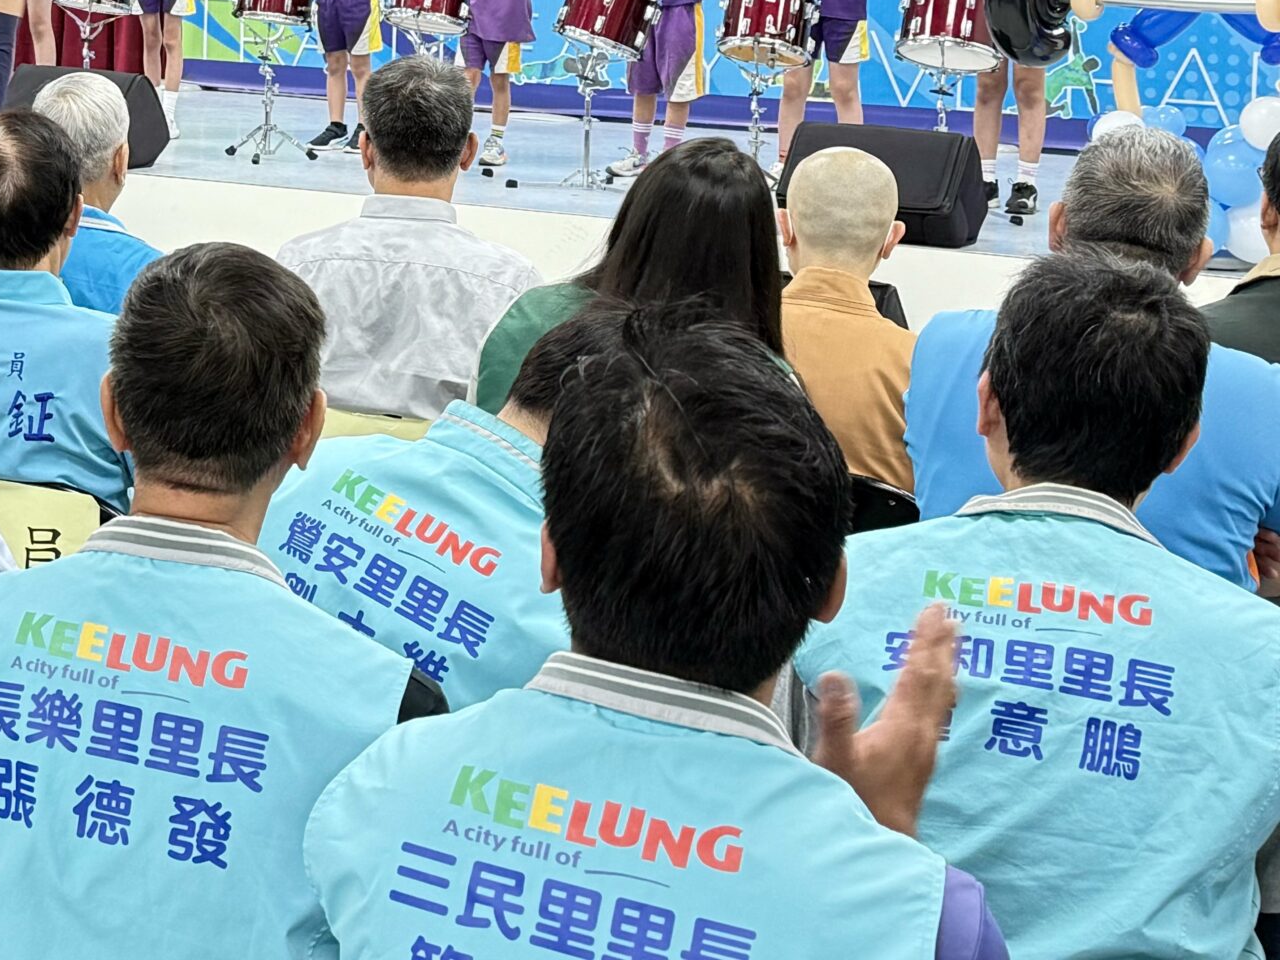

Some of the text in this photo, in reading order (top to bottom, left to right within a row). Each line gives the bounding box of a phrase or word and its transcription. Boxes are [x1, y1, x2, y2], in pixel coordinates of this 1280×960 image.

[321, 498, 401, 548] A city full of
[331, 468, 503, 577] KEELUNG
[279, 511, 495, 659] 鶯安里里長
[923, 569, 1153, 627] KEELUNG
[944, 607, 1032, 629] ity full of
[10, 656, 120, 690] A city full of
[15, 610, 250, 690] KEELUNG
[938, 698, 1143, 782] 意鵬
[442, 819, 583, 869] A city full of
[449, 764, 745, 873] KEELUNG
